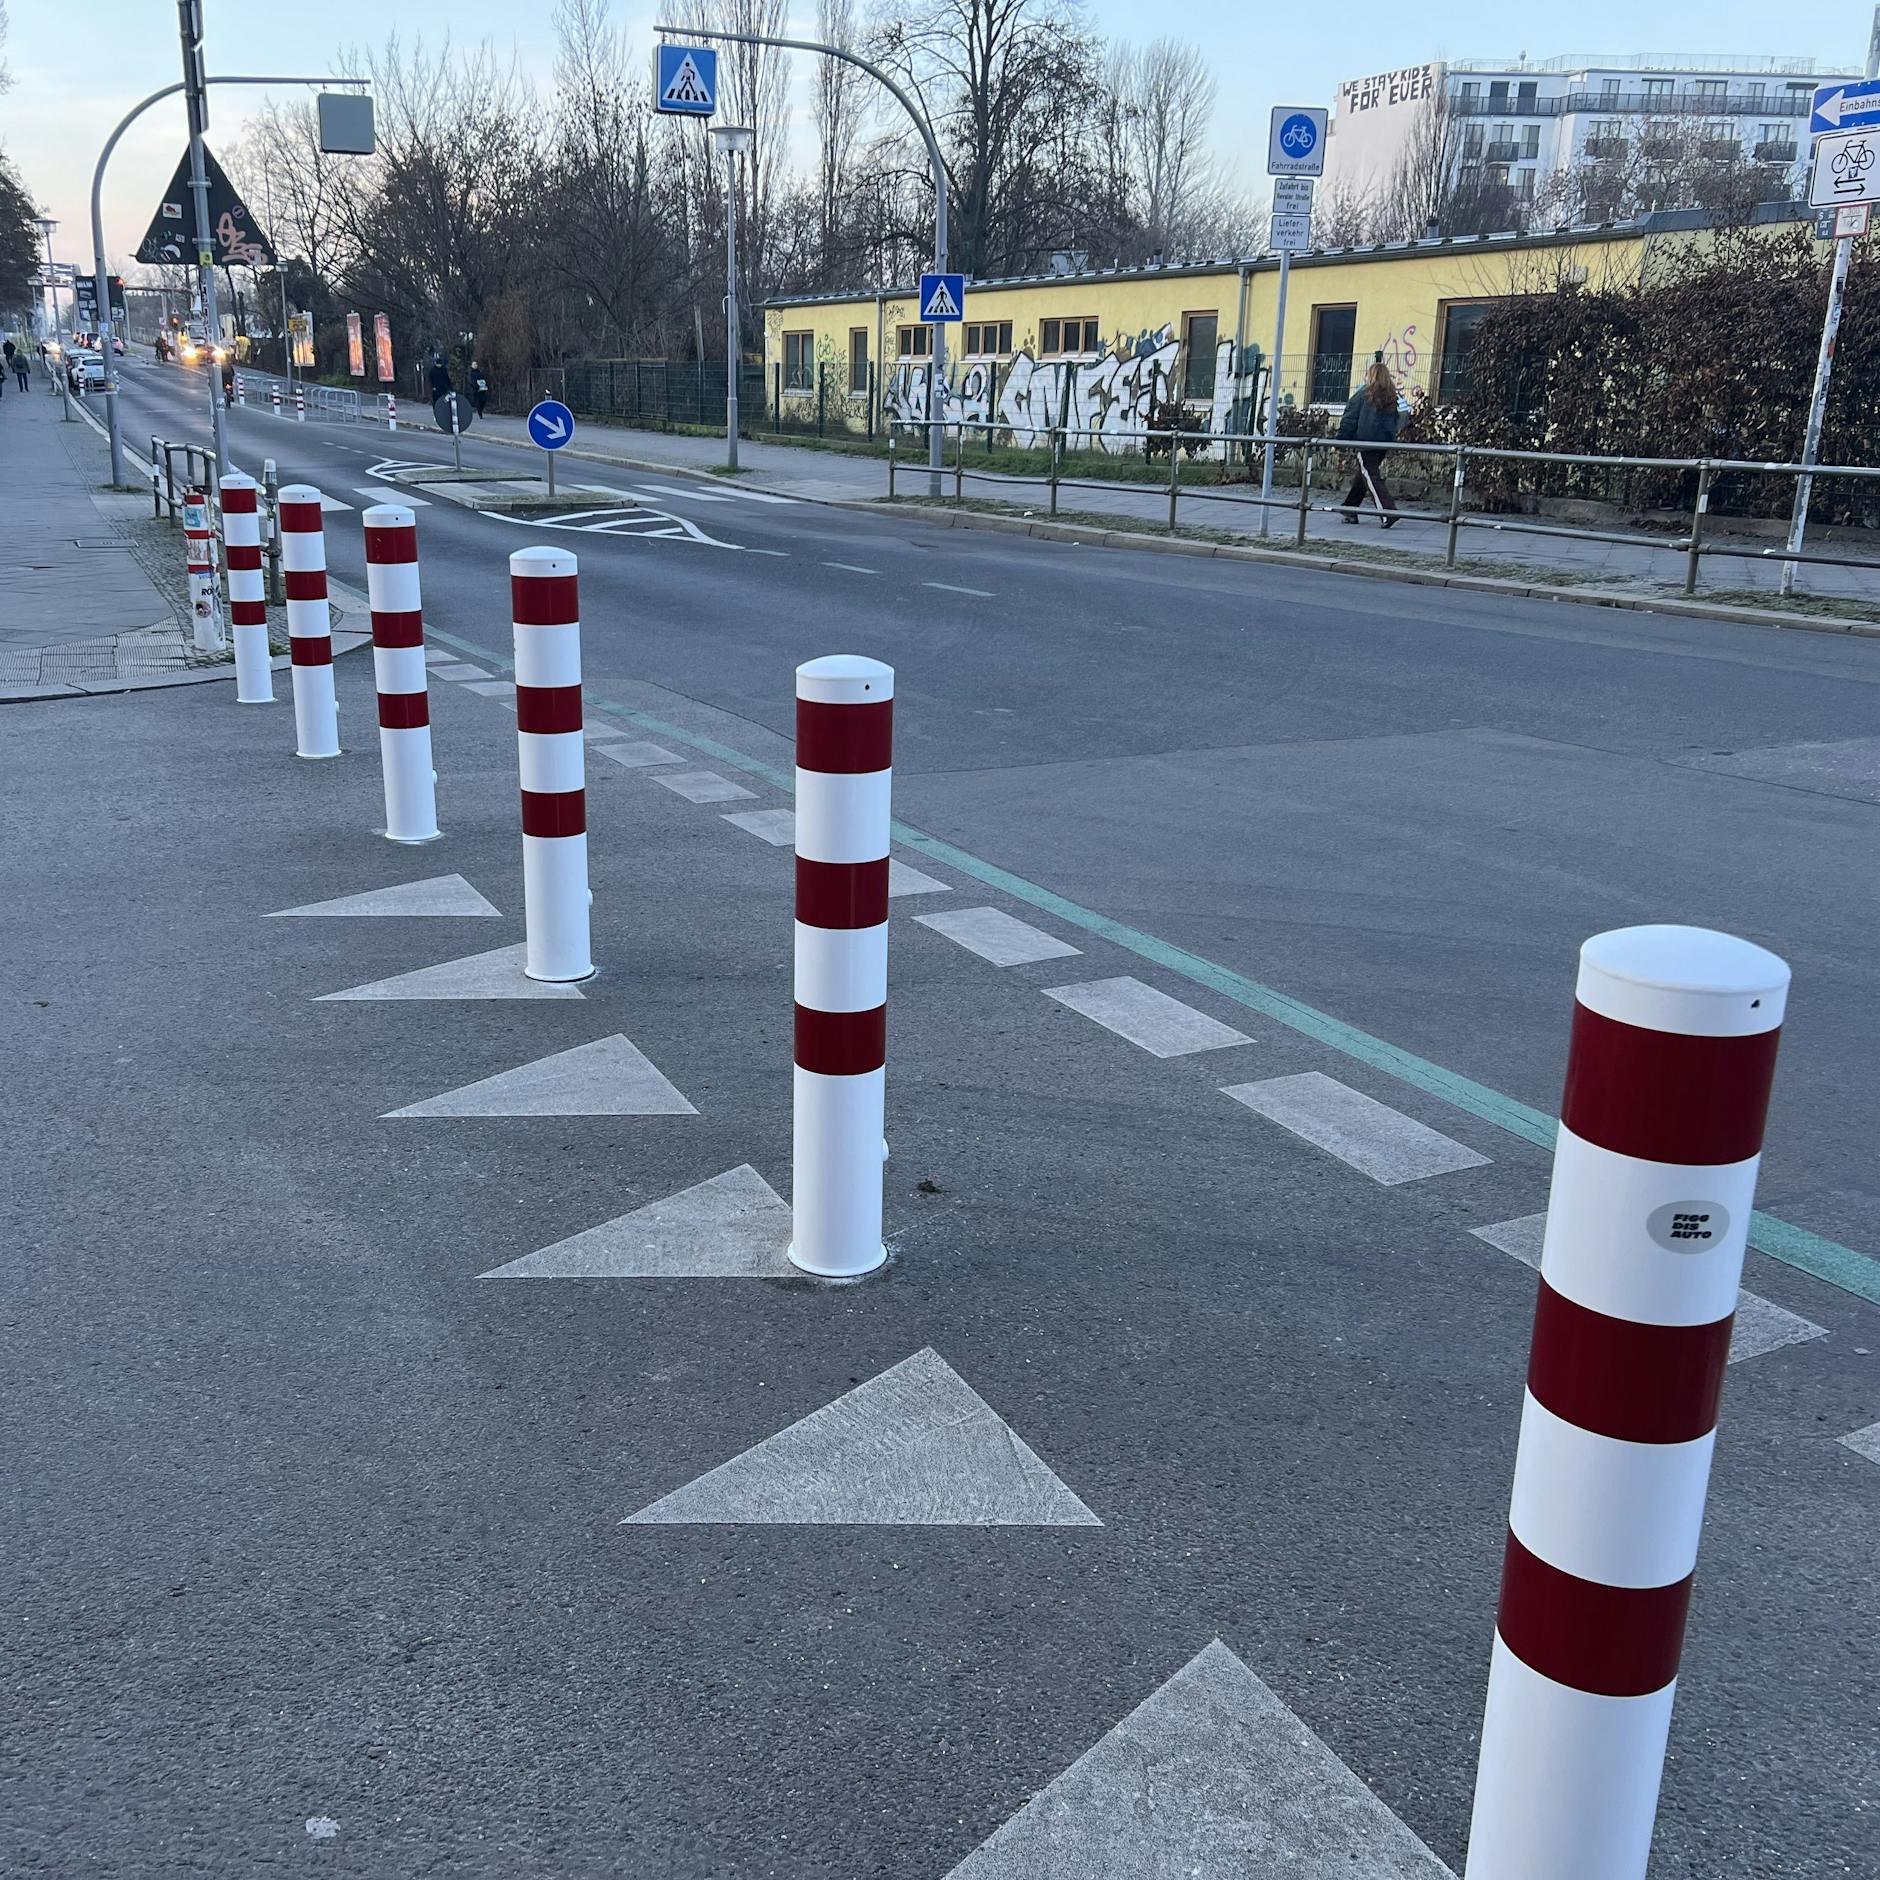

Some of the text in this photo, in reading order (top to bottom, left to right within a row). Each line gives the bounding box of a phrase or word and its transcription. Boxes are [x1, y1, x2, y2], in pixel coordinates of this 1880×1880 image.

[1343, 64, 1430, 96] WE STAY KIDZ
[1350, 88, 1379, 114] FOR
[1271, 161, 1320, 171] Fahrradstraße
[1279, 181, 1299, 191] Zufahrt
[1286, 201, 1299, 210] frei
[1278, 219, 1303, 228] Liefer-
[1276, 229, 1304, 237] verkehr
[1283, 239, 1296, 247] frei
[1671, 1222, 1699, 1230] DIS
[1669, 1230, 1712, 1239] AUTO
